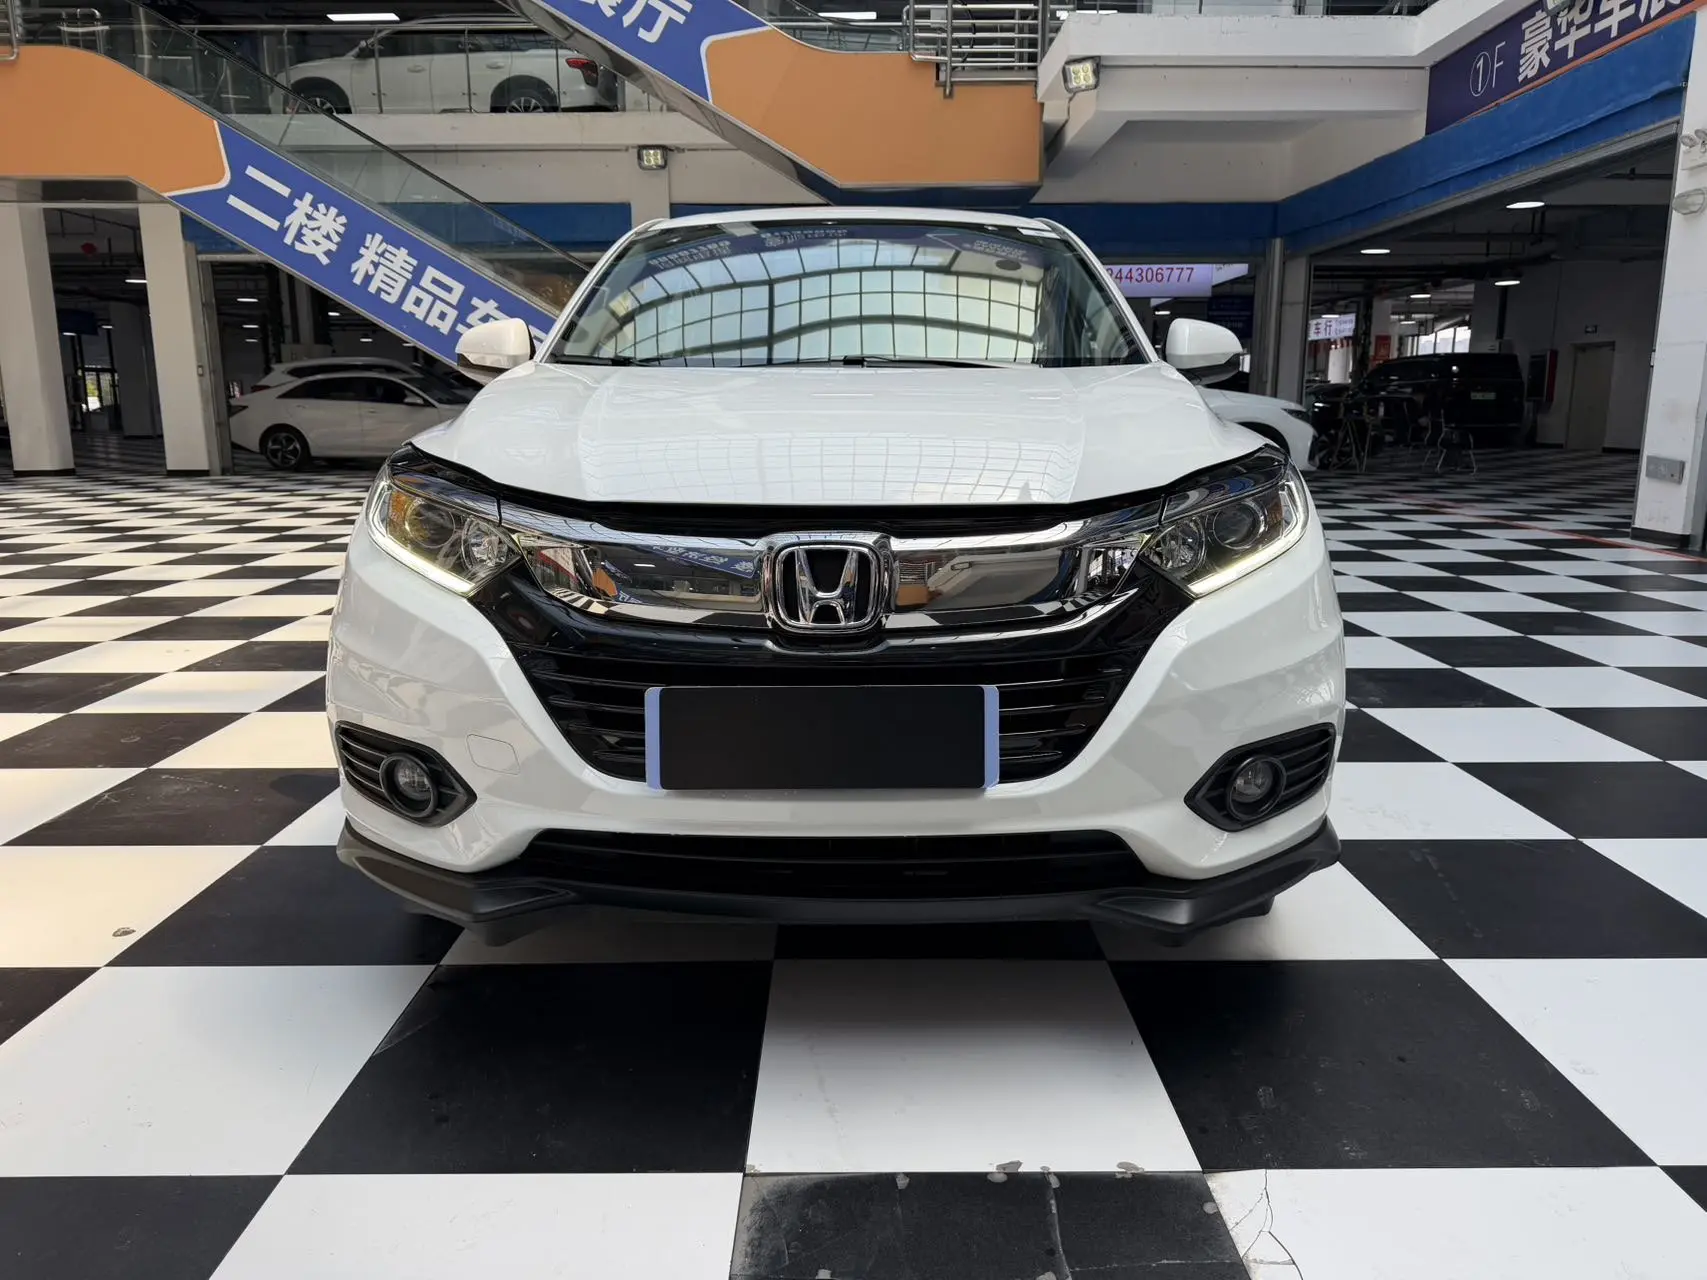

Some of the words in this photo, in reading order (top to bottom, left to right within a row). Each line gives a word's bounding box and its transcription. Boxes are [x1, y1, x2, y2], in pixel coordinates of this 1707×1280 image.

[579, 0, 693, 43] 厅
[226, 165, 347, 266] 二楼
[351, 233, 547, 351] 精品车
[1308, 320, 1333, 337] 车行
